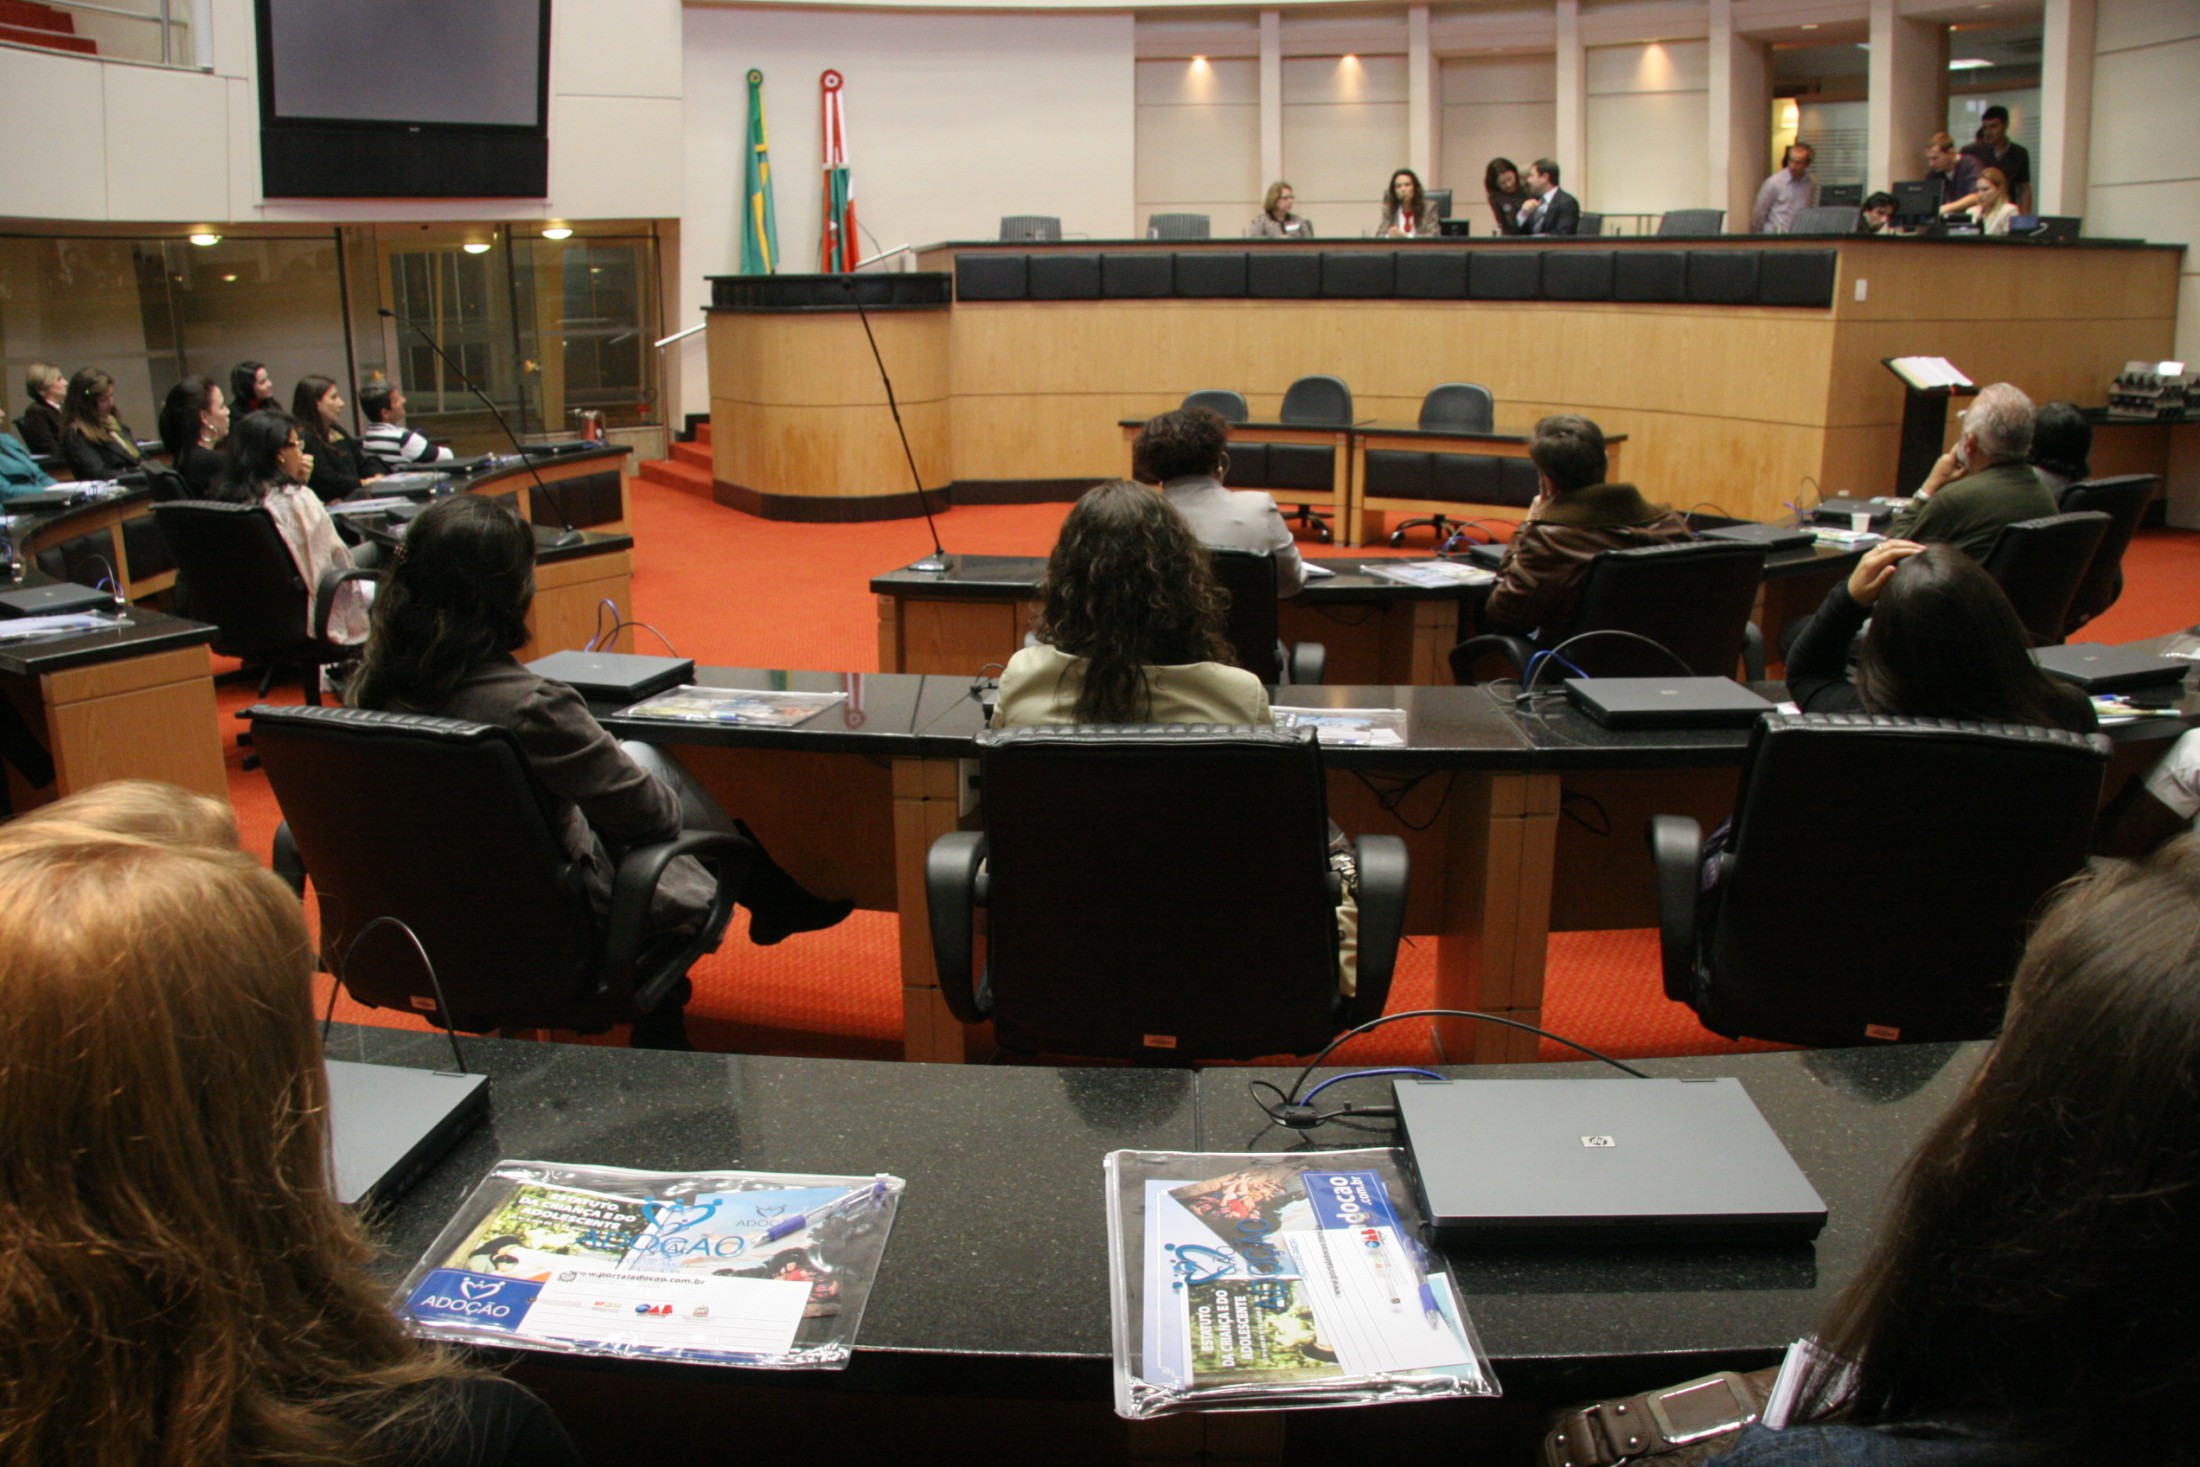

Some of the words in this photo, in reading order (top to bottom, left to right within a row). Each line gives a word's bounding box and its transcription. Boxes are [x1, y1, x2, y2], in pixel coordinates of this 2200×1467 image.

[518, 1196, 540, 1207] DA
[541, 1200, 600, 1219] CRIANÇA
[601, 1211, 613, 1220] E
[613, 1213, 637, 1223] DO
[550, 1193, 619, 1211] ESTATUTO
[520, 1207, 621, 1230] ADOLESCENTE
[421, 1295, 510, 1319] ADOÇÃO
[1215, 1290, 1229, 1304] DO
[1198, 1306, 1214, 1352] ESTATUTO
[1218, 1311, 1234, 1352] CRIANÇA
[1234, 1296, 1254, 1360] ADOLESCENTE
[1222, 1353, 1235, 1367] DA
